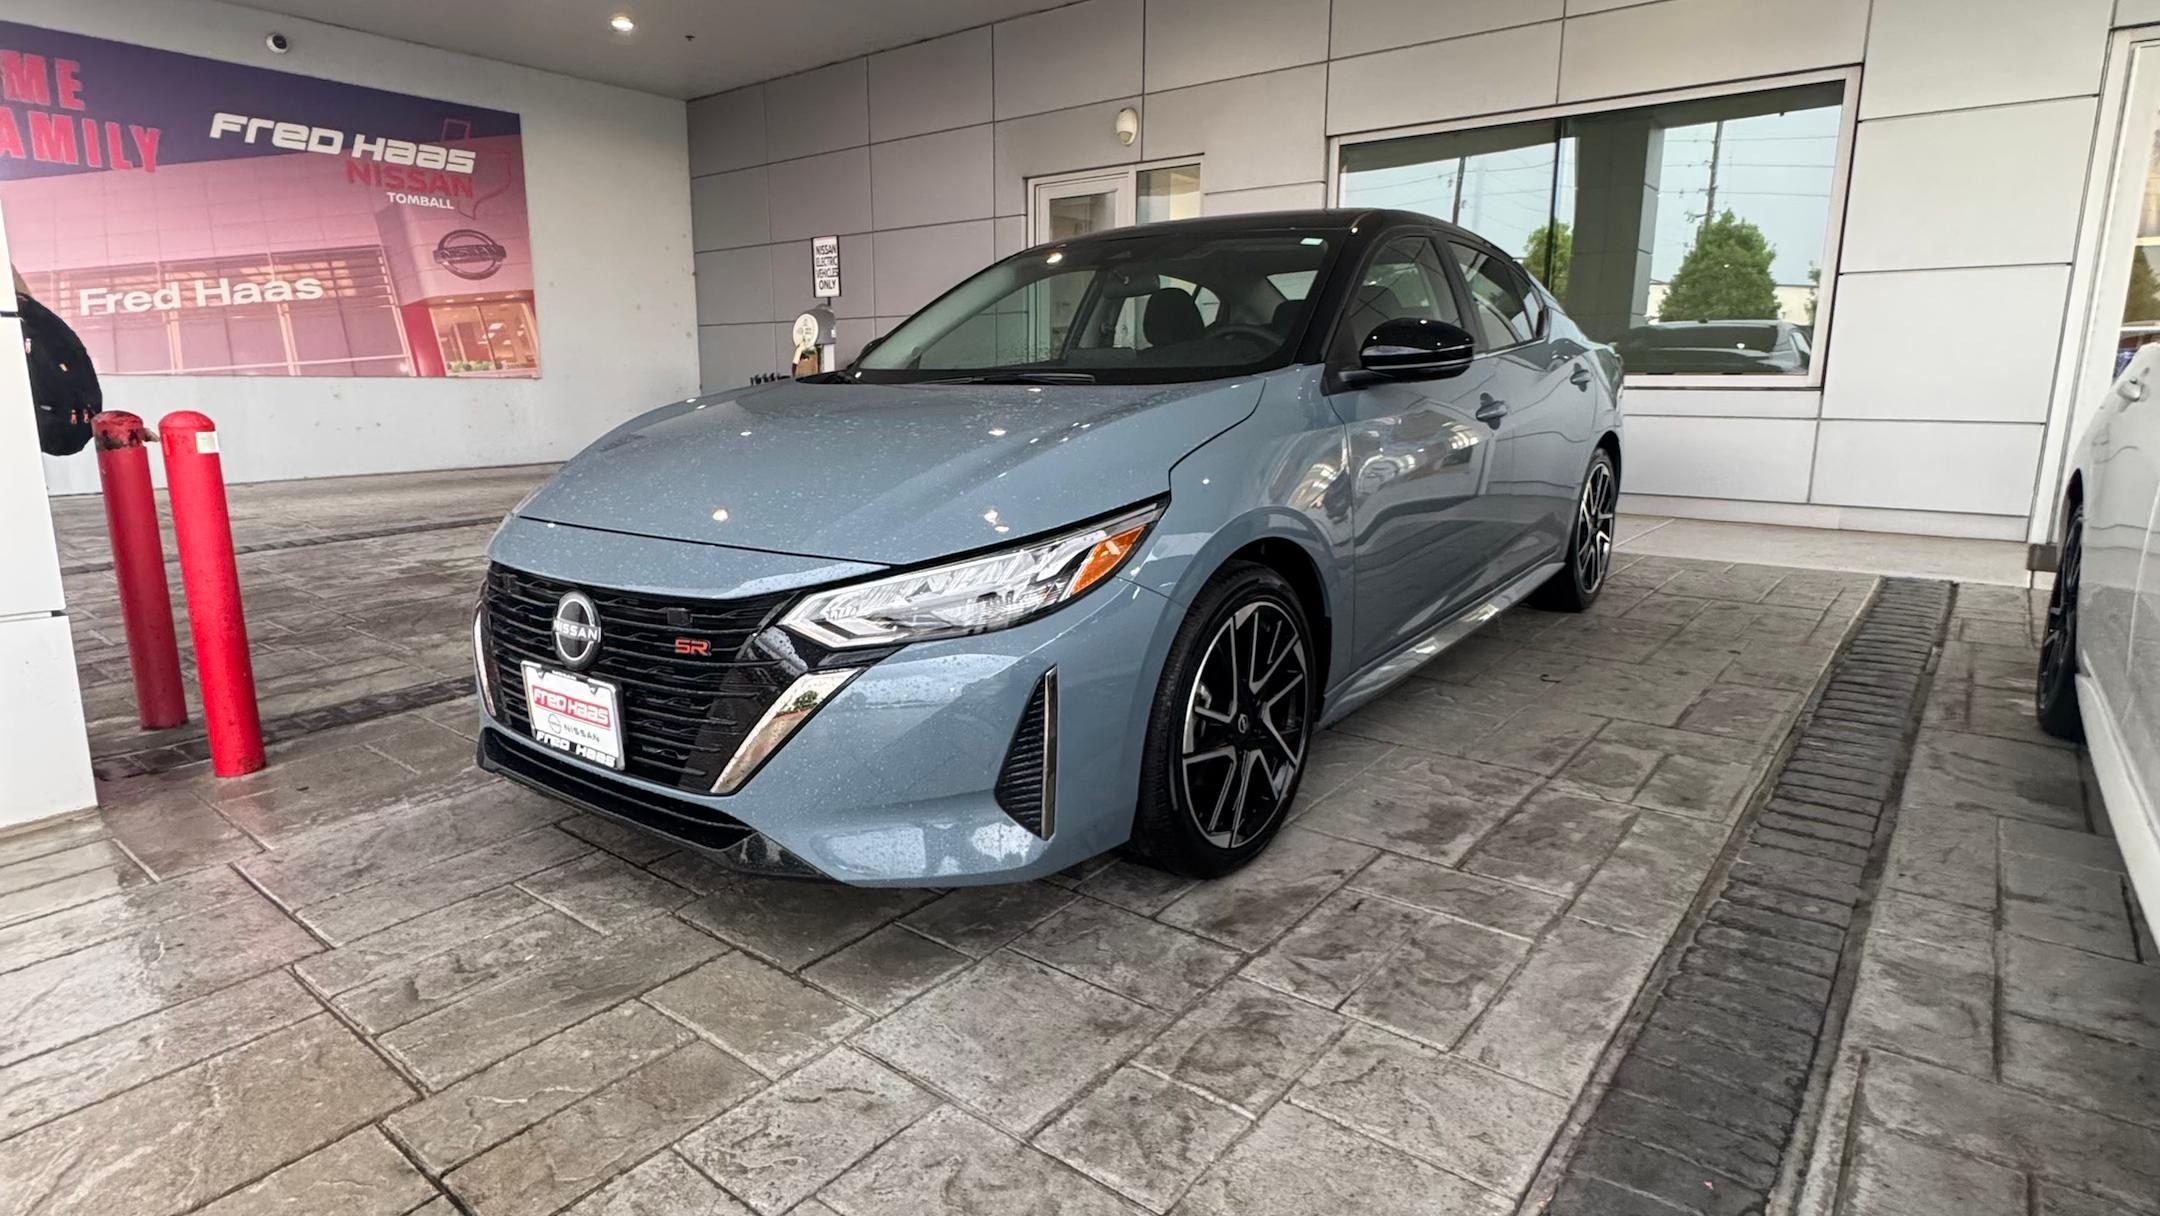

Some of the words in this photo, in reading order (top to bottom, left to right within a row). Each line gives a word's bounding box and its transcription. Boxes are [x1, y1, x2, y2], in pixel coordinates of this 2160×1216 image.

[345, 160, 474, 197] NISSAN
[386, 192, 454, 210] TOMBALL
[816, 245, 837, 255] NISSAN
[816, 256, 838, 267] ELECTRIC
[819, 280, 836, 290] ONLY
[79, 282, 181, 316] Fred
[195, 278, 323, 307] Haas
[553, 619, 597, 640] NISSAN
[675, 639, 709, 656] SR
[564, 724, 600, 742] NISSAN
